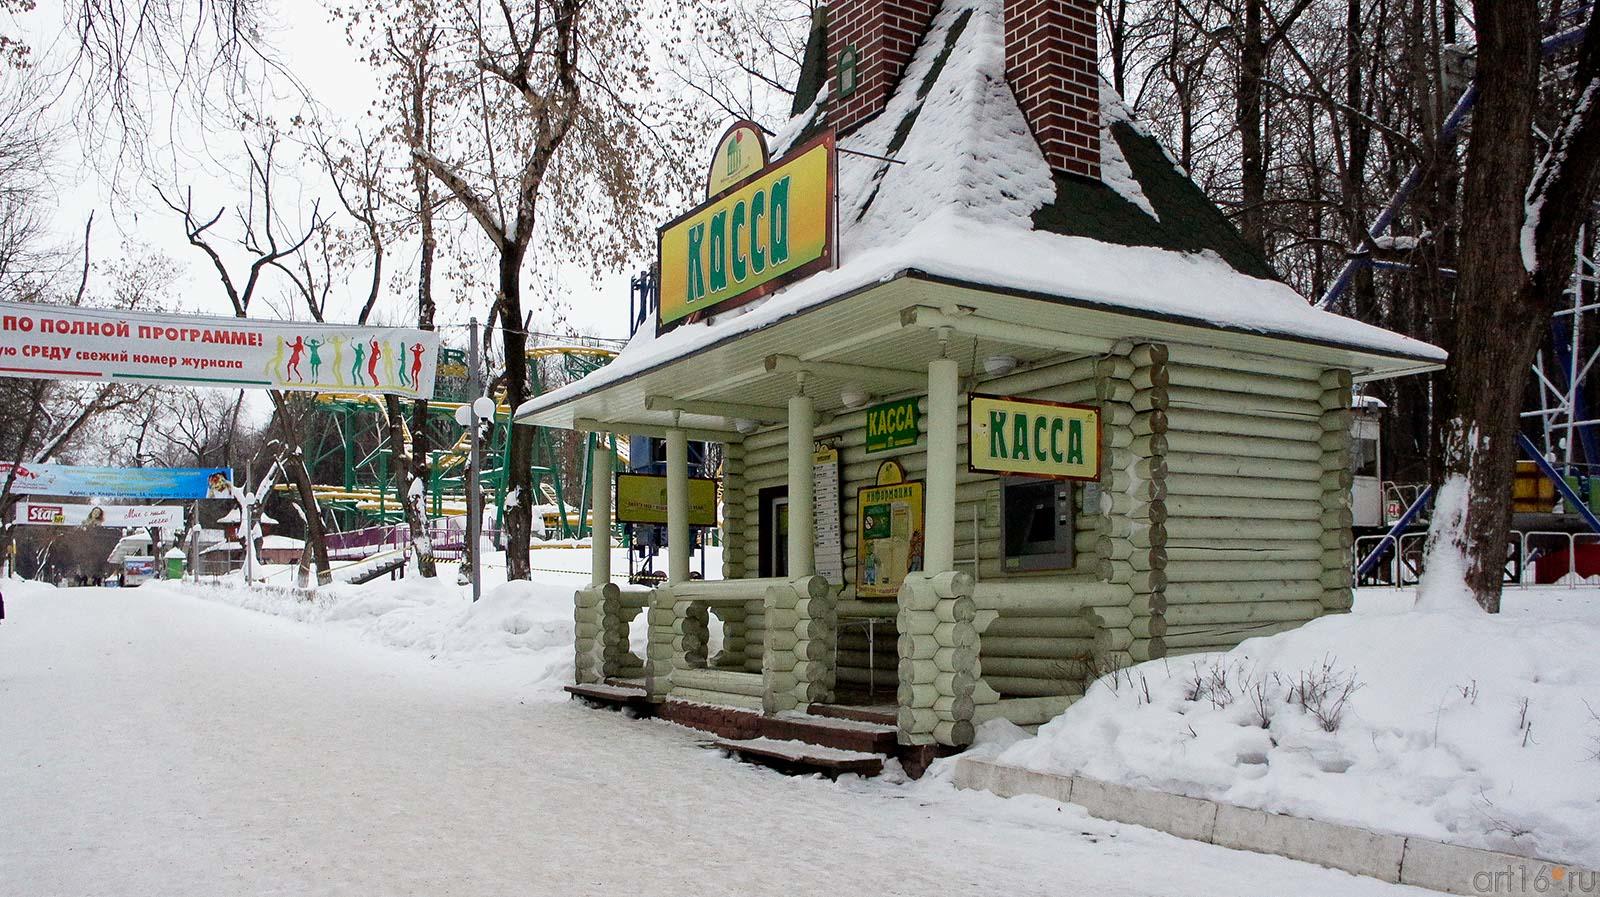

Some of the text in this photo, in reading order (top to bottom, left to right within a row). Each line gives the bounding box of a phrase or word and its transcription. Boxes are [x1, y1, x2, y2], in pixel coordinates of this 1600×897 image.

[3, 315, 263, 347] ПО ПОЛНОЙ ПРОГРАММЕ!
[22, 344, 72, 361] СРЕДУ
[76, 350, 129, 363] свежий
[133, 354, 178, 367] номер
[181, 357, 243, 370] журнала
[869, 404, 914, 437] КАССА
[989, 410, 1084, 465] КАССА
[29, 507, 60, 520] Star
